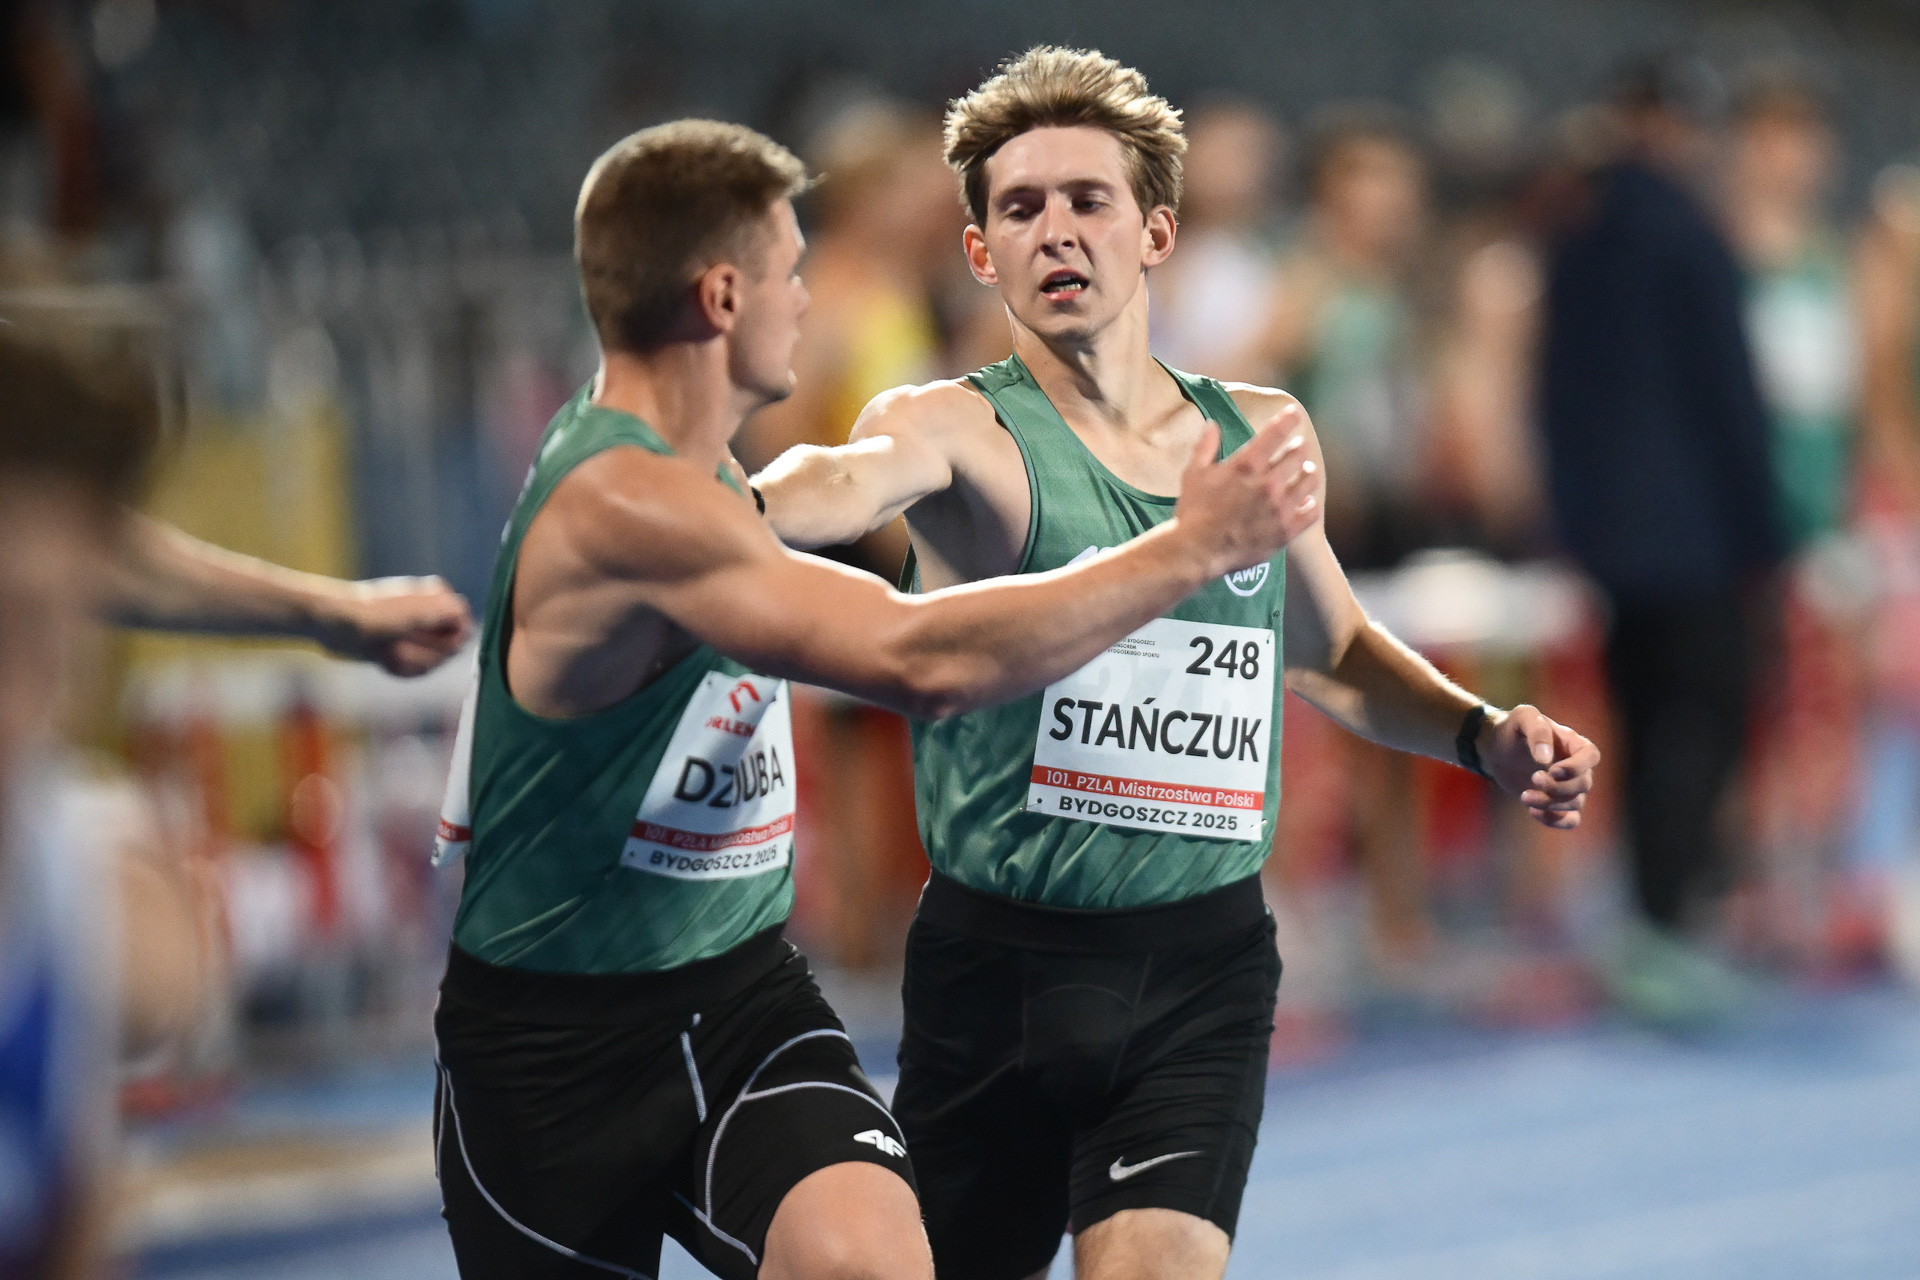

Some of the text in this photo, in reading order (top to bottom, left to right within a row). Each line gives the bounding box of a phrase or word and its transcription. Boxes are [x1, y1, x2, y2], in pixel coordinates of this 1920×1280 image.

[1231, 565, 1264, 583] AWF
[1186, 636, 1260, 680] 248
[1049, 697, 1262, 762] STAŃCZUK
[673, 744, 785, 808] DZIUBA
[1046, 769, 1255, 807] 101. PZLA Mistrzostwa Polski
[1059, 795, 1238, 831] BYDGOSZCZ 2025
[649, 844, 778, 871] BYDGOSZCZ 2025
